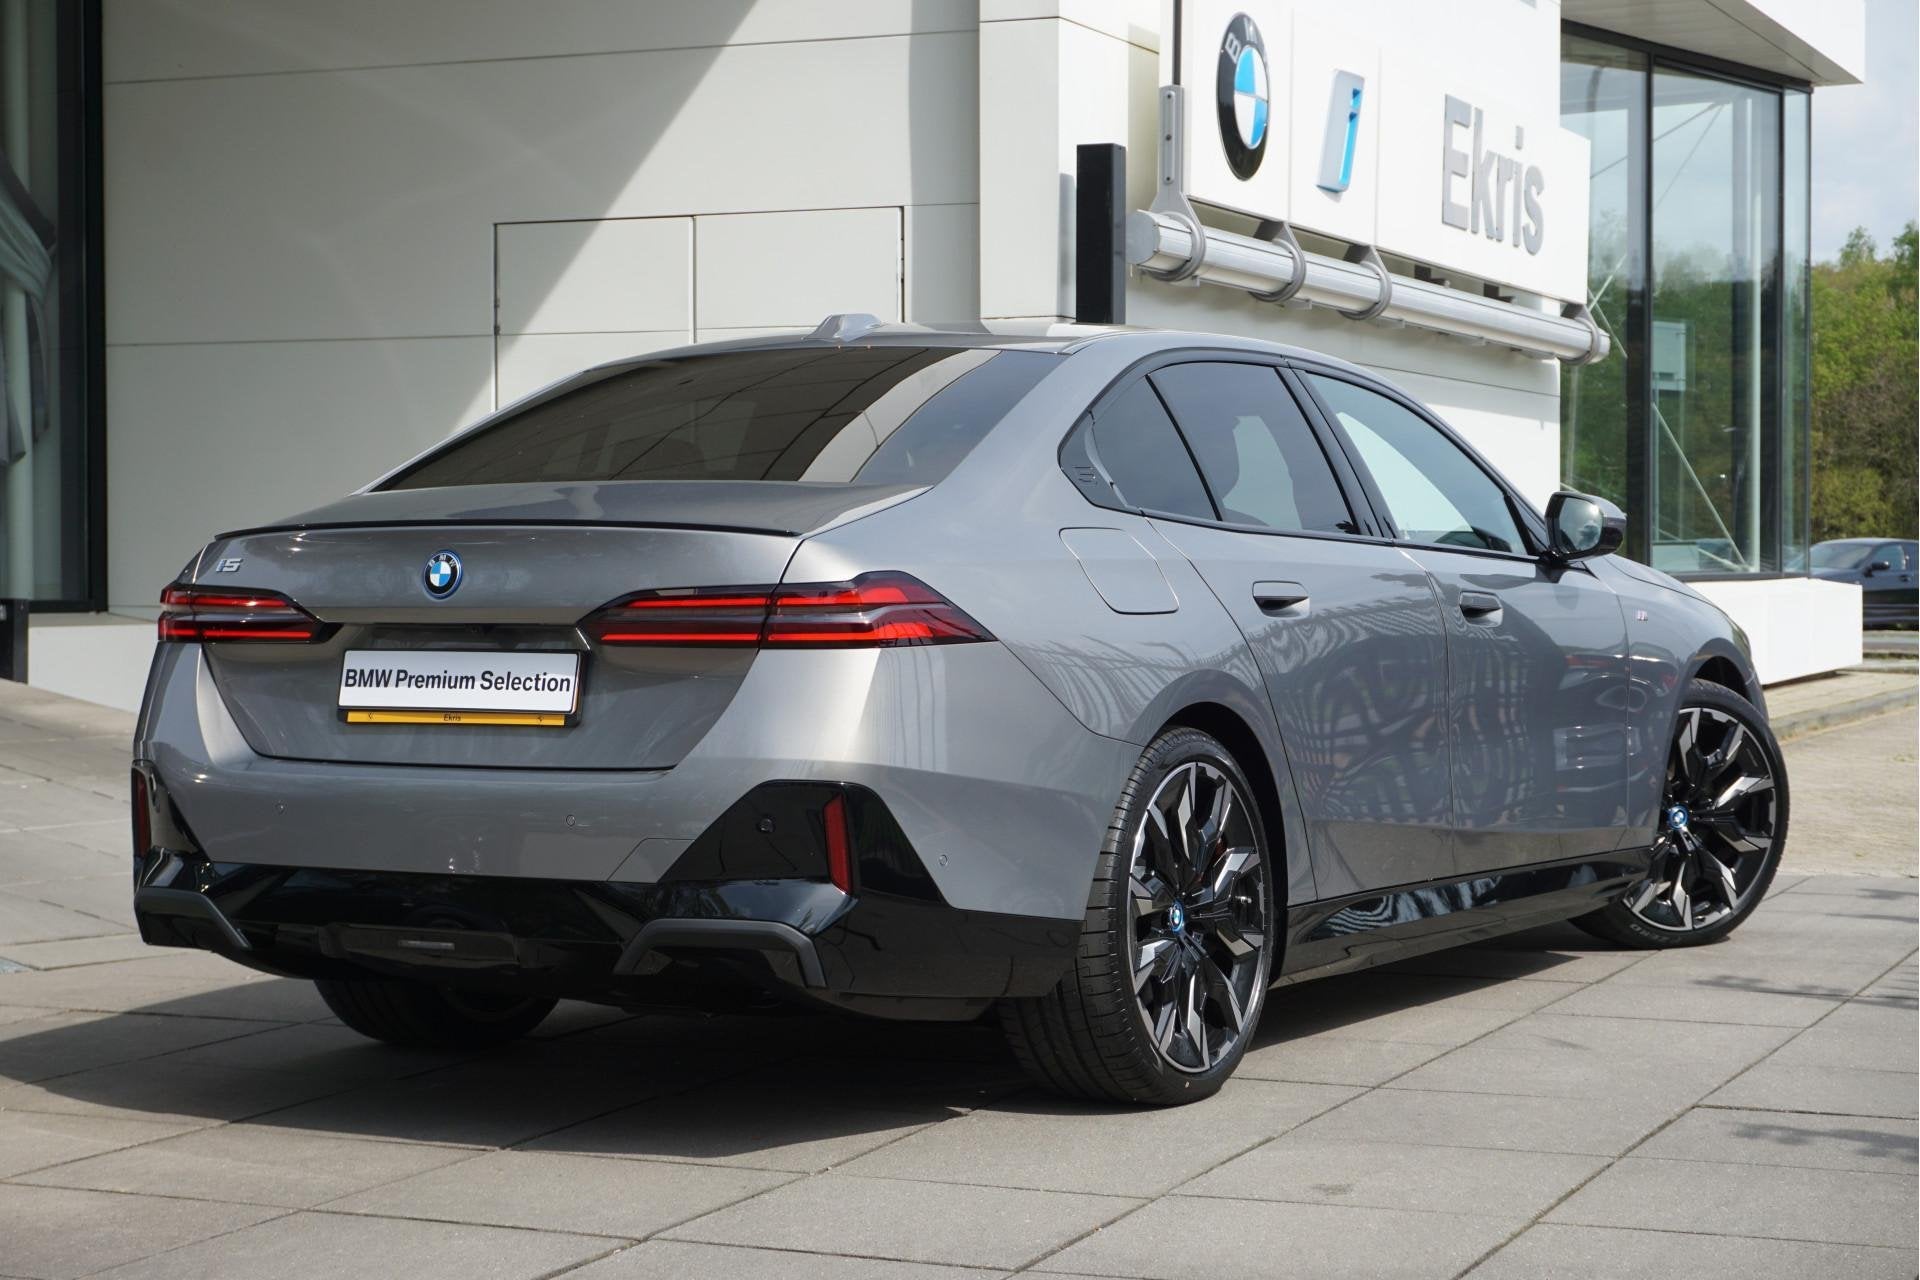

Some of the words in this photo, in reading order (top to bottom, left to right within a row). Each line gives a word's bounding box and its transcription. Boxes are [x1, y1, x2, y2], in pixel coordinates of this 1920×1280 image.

[1442, 93, 1544, 256] Ekris
[344, 668, 393, 688] BMW
[395, 669, 475, 690] Premium
[480, 670, 571, 692] Selection
[443, 713, 462, 721] Ekris
